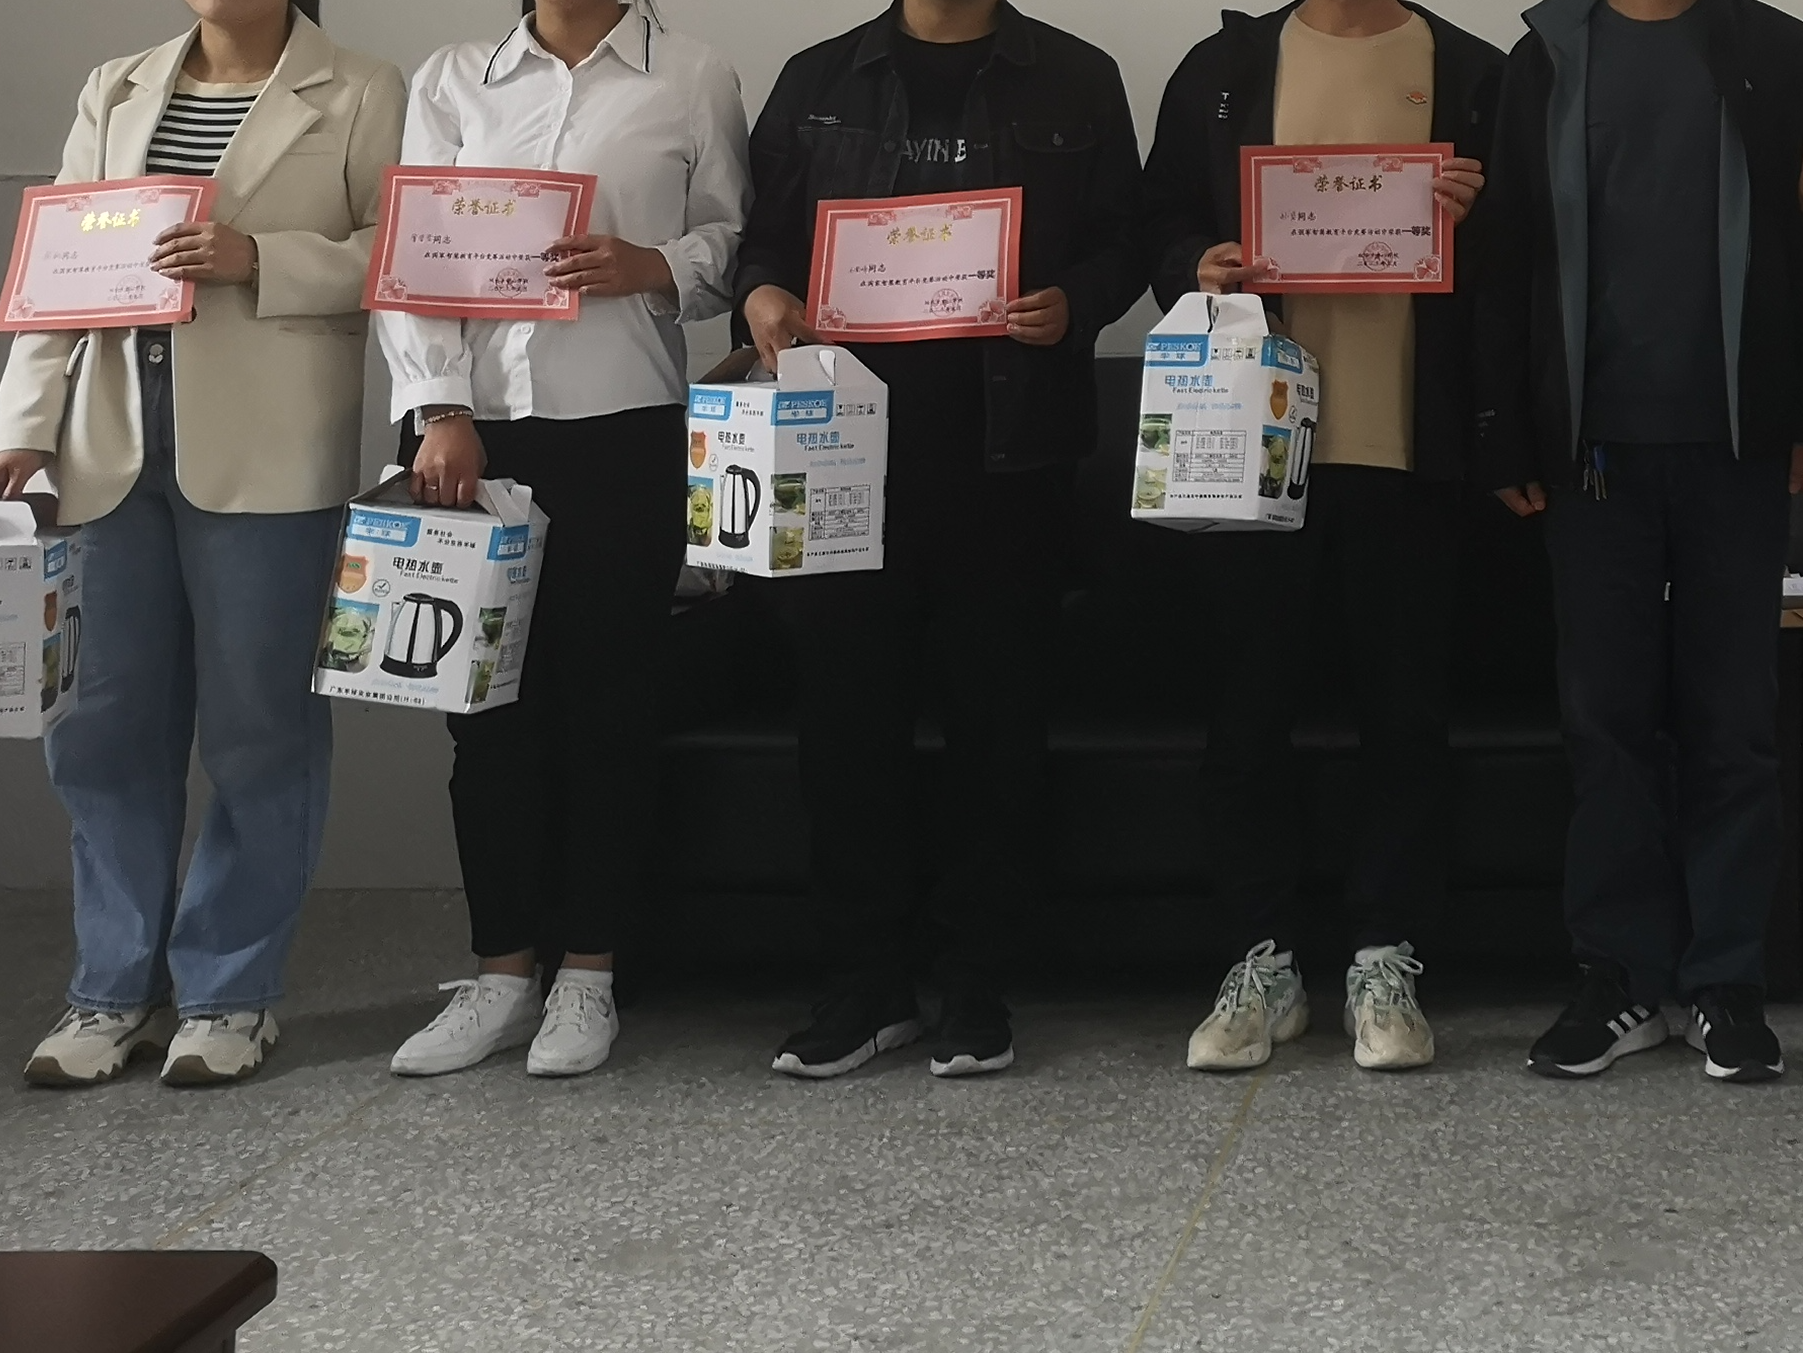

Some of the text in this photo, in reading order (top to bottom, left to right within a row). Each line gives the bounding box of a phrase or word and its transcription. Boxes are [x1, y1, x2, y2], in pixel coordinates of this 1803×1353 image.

[1313, 174, 1384, 193] 荣誉证书
[451, 197, 517, 216] 荣誉证书
[80, 208, 141, 233] 荣誉证书
[886, 222, 954, 245] 荣誉证书
[1165, 375, 1214, 387] 电热水壶
[392, 556, 444, 575] 电热水壶
